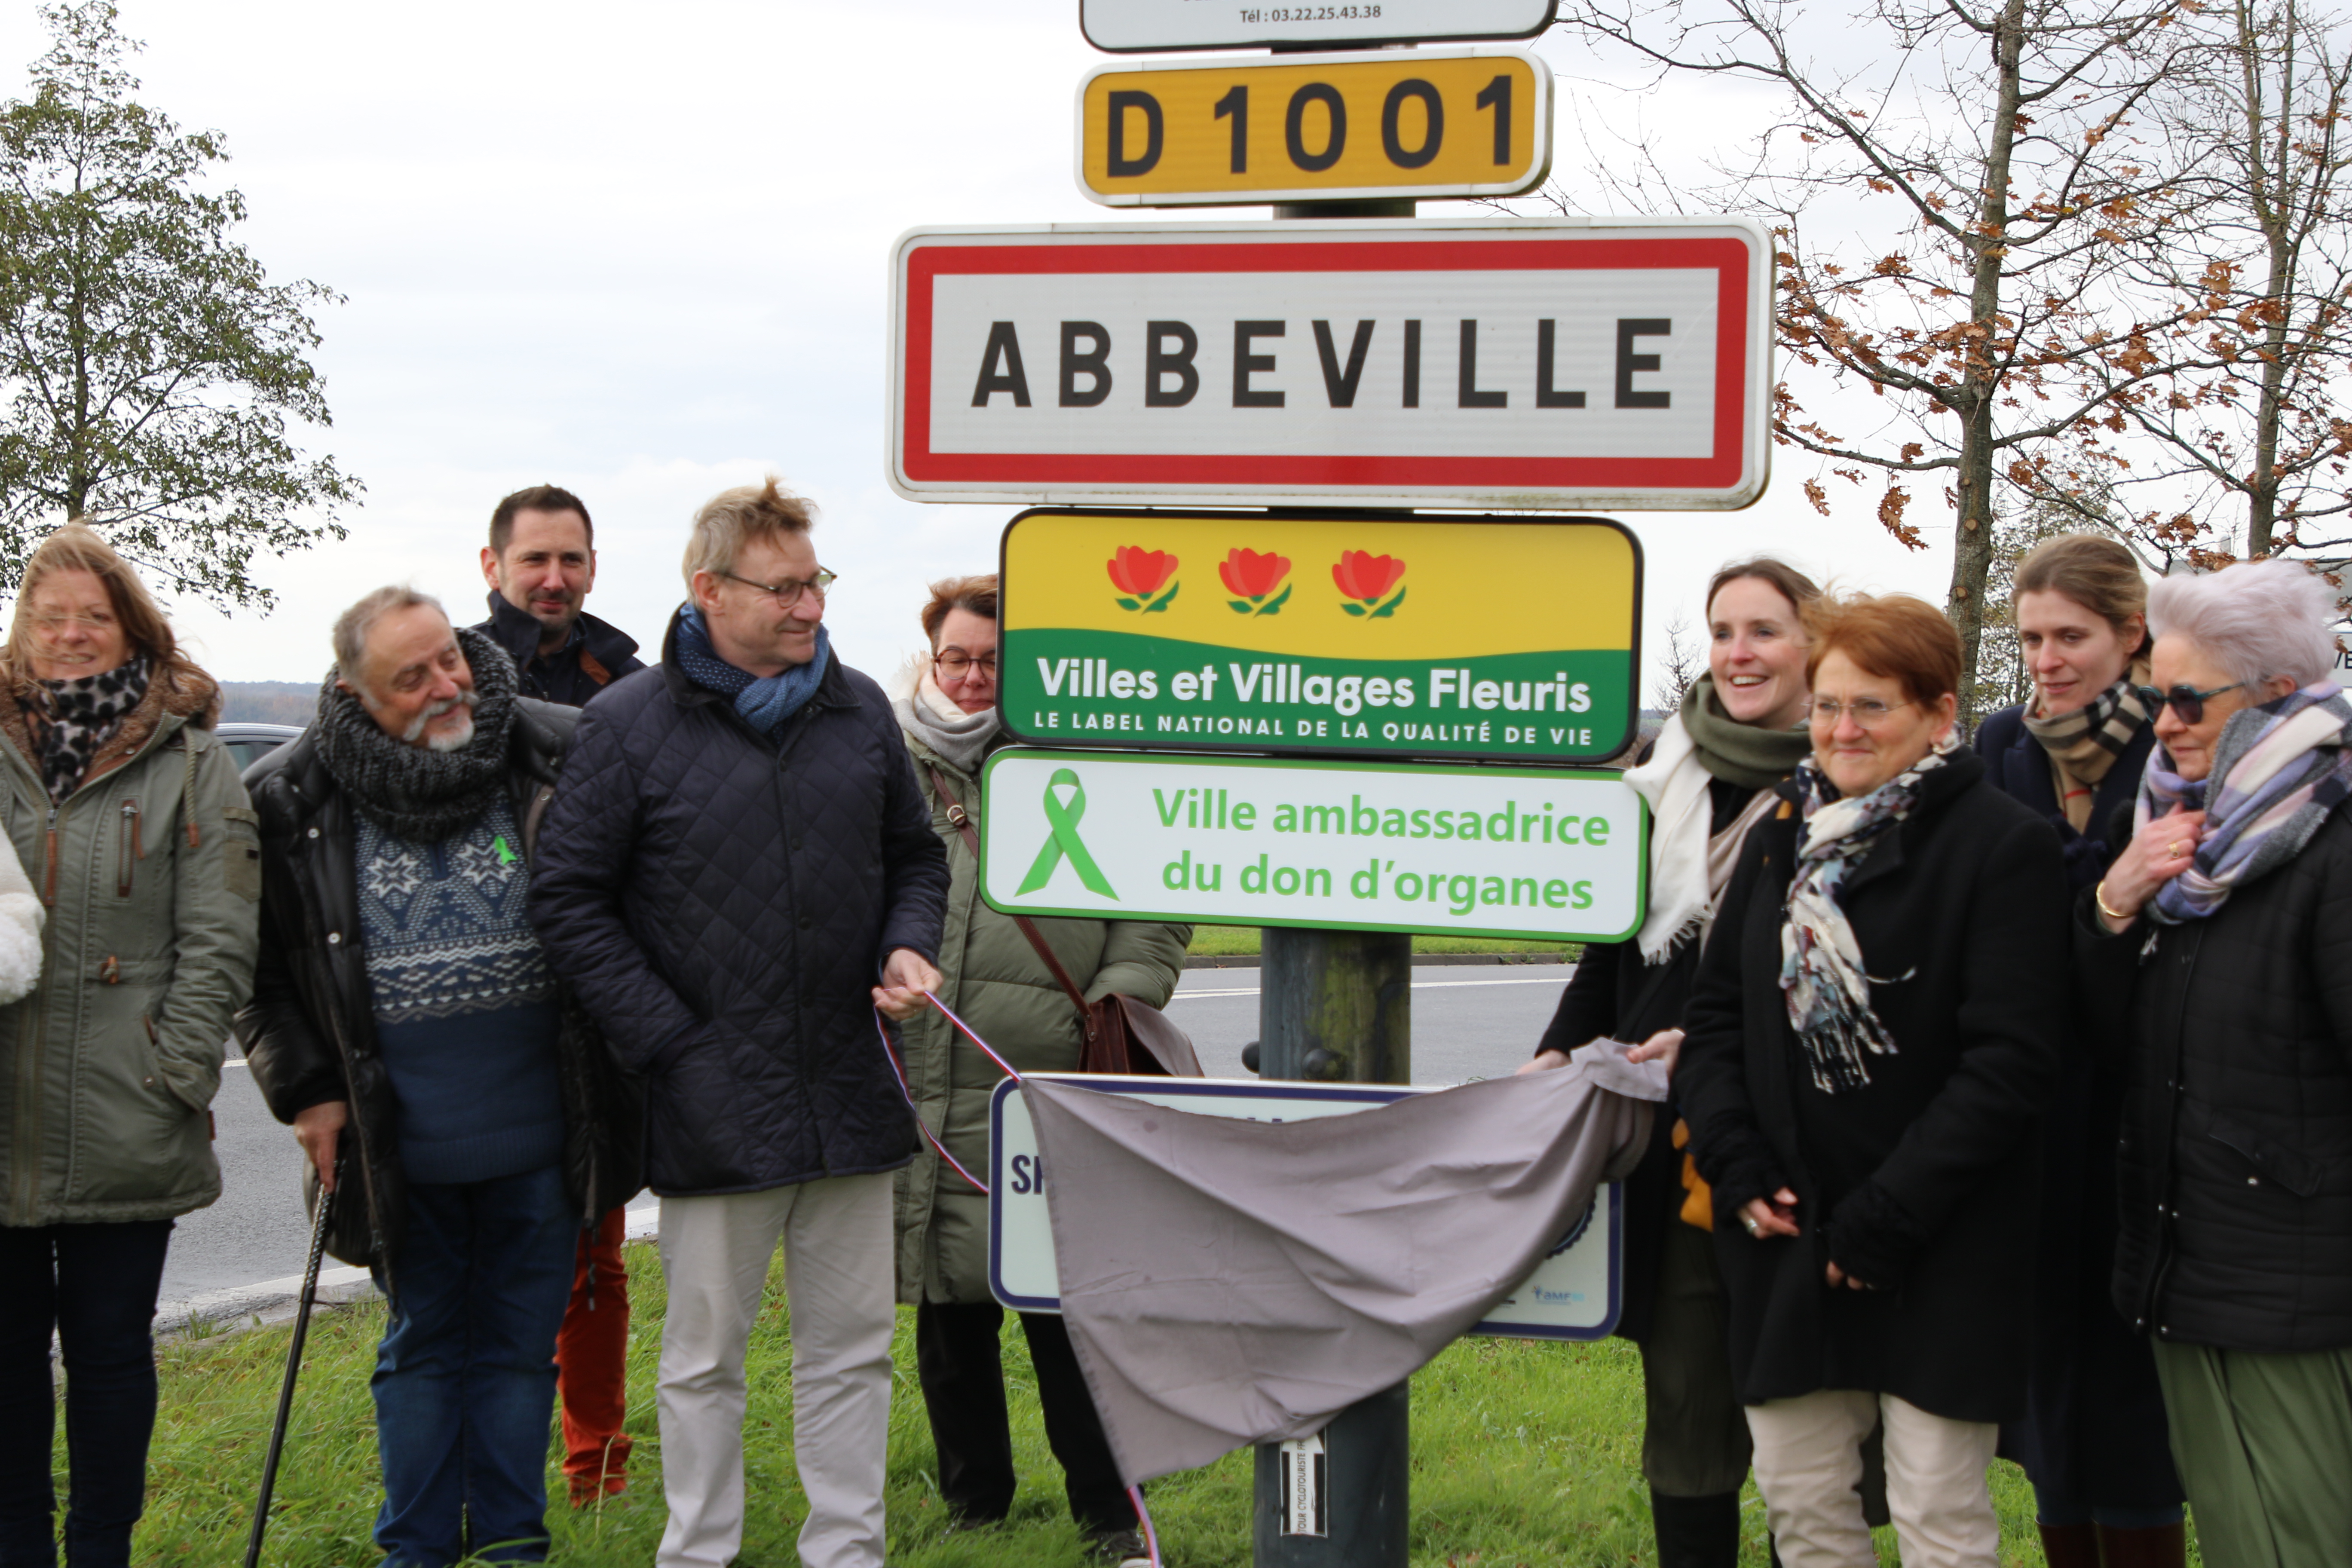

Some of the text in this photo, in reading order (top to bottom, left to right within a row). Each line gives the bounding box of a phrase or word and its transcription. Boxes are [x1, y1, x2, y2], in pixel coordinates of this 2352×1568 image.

[1240, 9, 1260, 22] Tél
[1271, 6, 1381, 22] 03.22.25.43.38
[1107, 75, 1512, 178] D 1001
[971, 318, 1671, 409] ABBEVILLE
[1037, 658, 1591, 717] Villes et Villages Fleuris
[1035, 711, 1592, 746] LE LABEL NATIONAL DE LA QUALITÉ DE VIE
[1153, 788, 1610, 846] Ville ambassadrice
[1163, 850, 1593, 916] du don d'organes
[1297, 1453, 1307, 1511] CYCLOTOURISTE
[1297, 1513, 1307, 1534] TOUR
